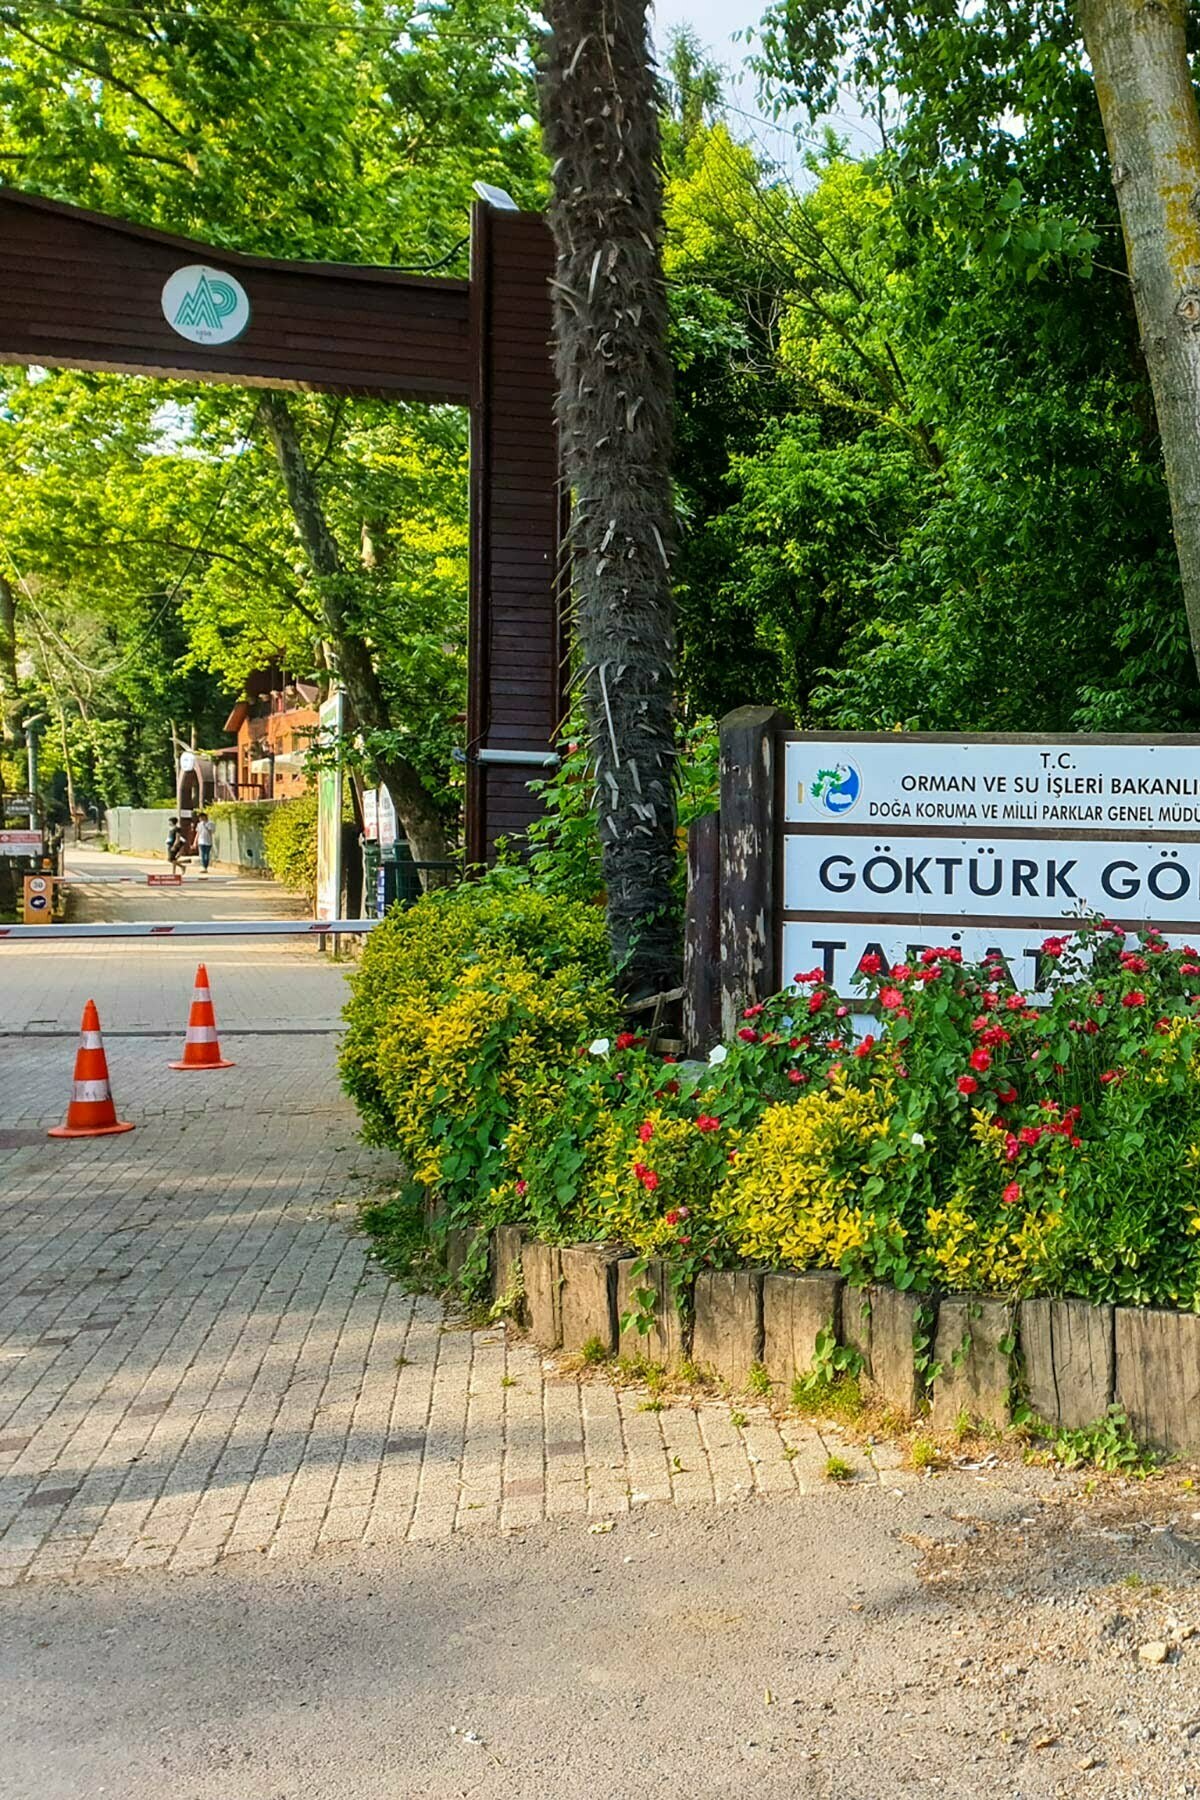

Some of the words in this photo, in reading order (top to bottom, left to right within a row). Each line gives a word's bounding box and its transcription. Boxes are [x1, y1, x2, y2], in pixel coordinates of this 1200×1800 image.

[1039, 752, 1076, 770] T.C.
[901, 775, 976, 793] ORMAN
[982, 776, 1007, 793] VE
[1013, 776, 1040, 794] SU
[1047, 773, 1103, 798] İŞLERİ
[869, 799, 911, 818] DOĞA
[916, 802, 977, 819] KORUMA
[983, 803, 998, 819] VE
[1002, 800, 1038, 820] MİLLİ
[1042, 805, 1103, 821] PARKLAR
[1107, 805, 1154, 822] GENEL
[818, 845, 1078, 898] GÖKTÜRK
